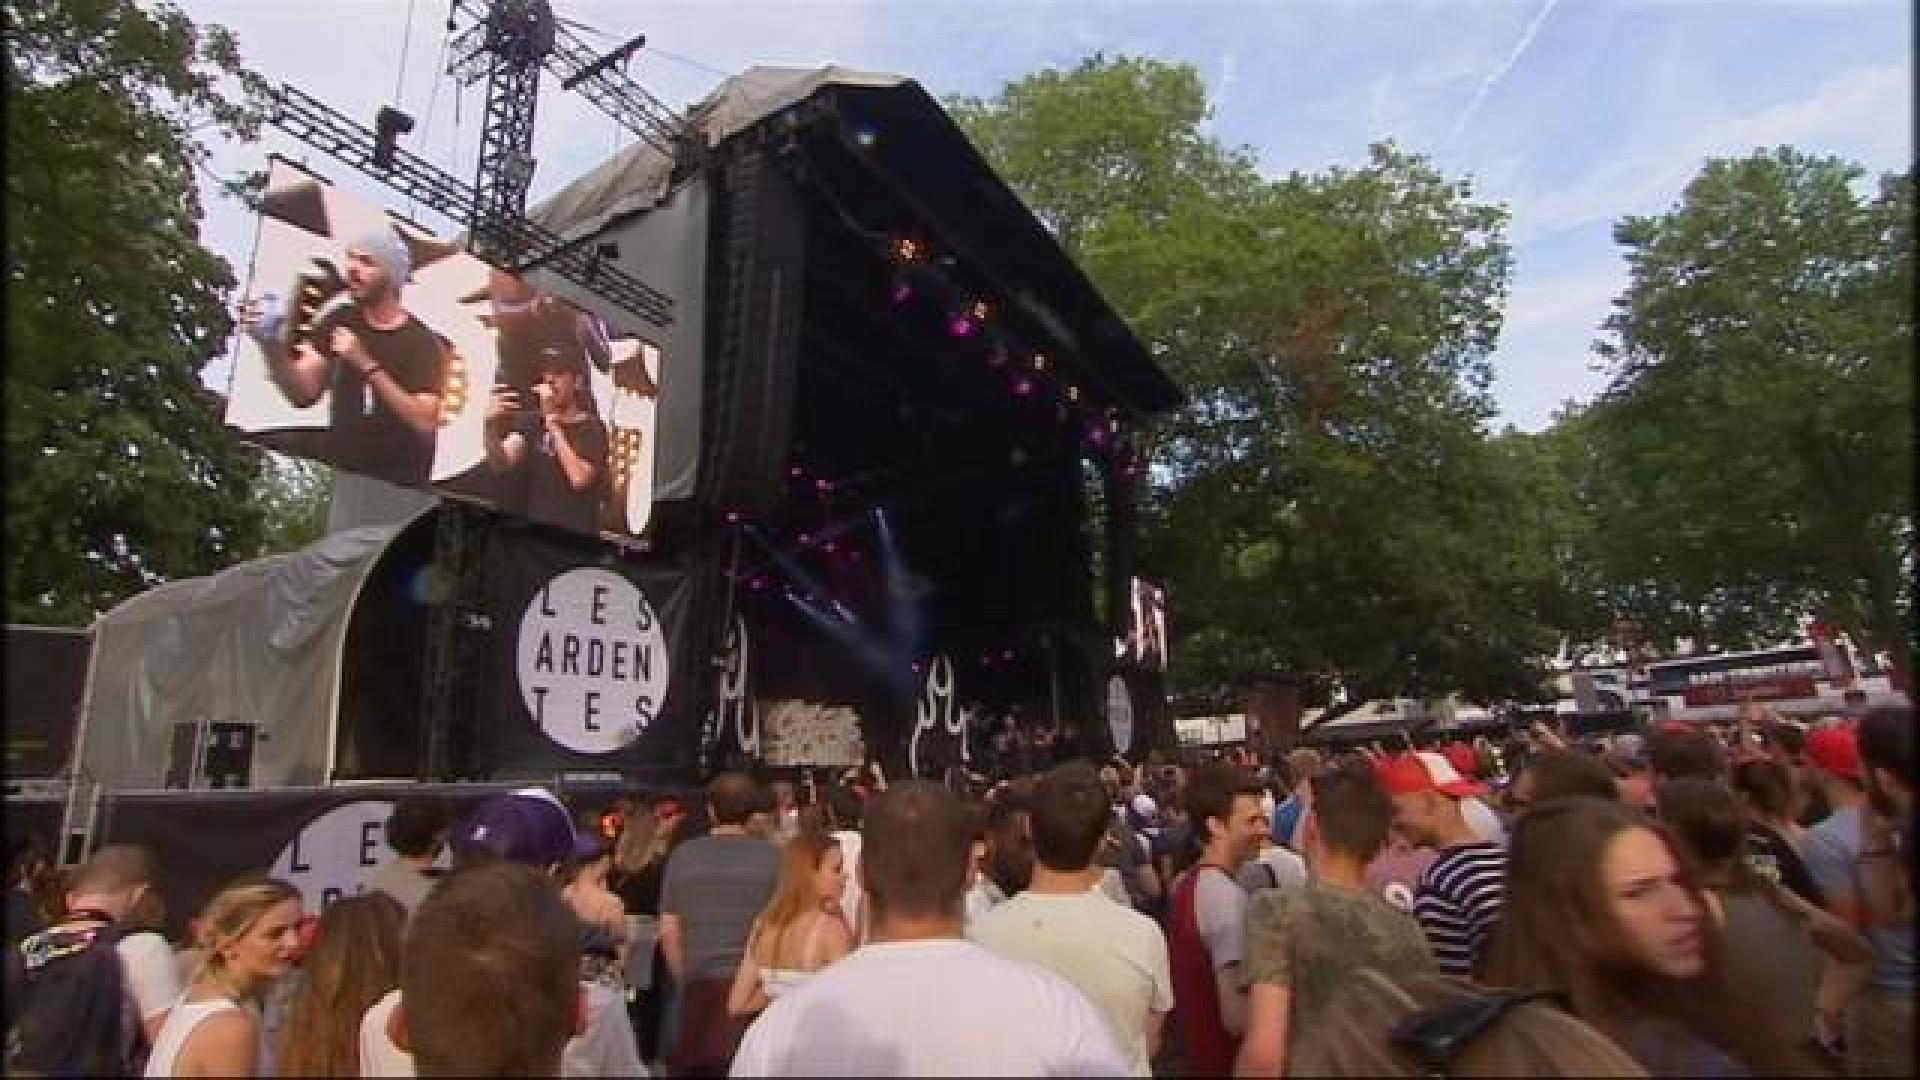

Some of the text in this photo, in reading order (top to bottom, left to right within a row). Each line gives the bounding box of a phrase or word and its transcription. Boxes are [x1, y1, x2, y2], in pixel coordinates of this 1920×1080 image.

[540, 584, 652, 631] LES
[533, 631, 652, 682] ARDEN
[531, 686, 652, 734] TES
[289, 821, 382, 874] LE
